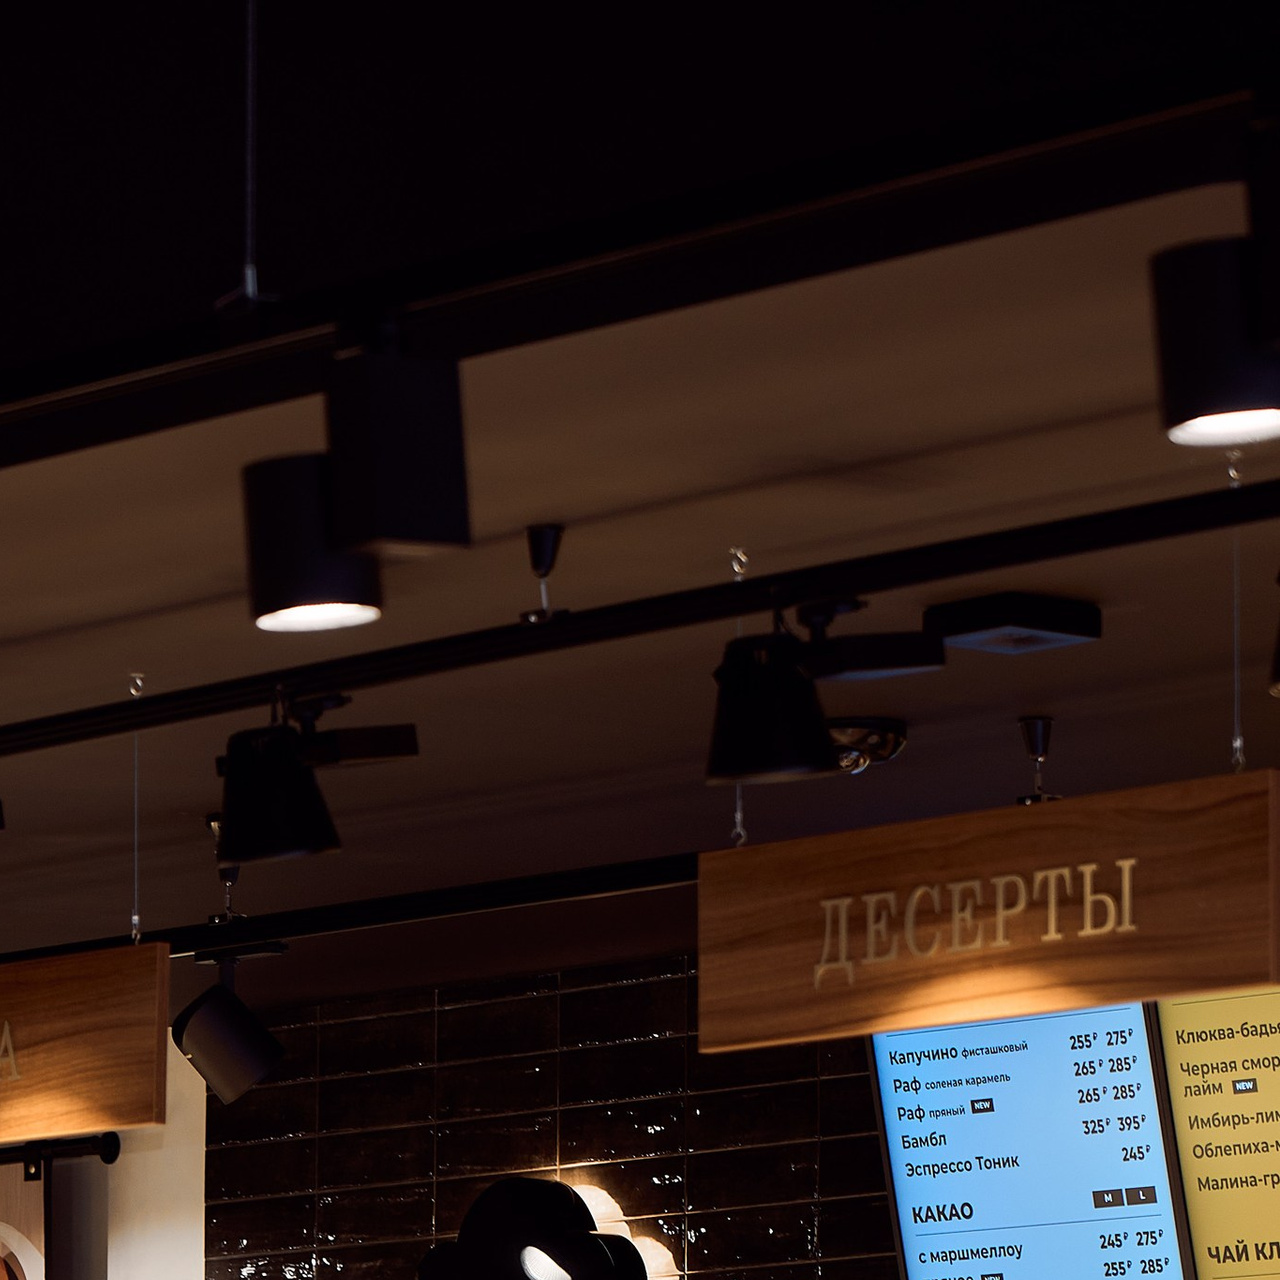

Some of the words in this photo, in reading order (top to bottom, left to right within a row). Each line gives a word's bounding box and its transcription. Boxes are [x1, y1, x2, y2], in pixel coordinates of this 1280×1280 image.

[813, 858, 1138, 990] ДЕСЕРТЫ
[889, 1047, 958, 1066] Капучино
[961, 1040, 1028, 1059] фисташковый
[1180, 1059, 1237, 1079] Черная
[893, 1076, 921, 1094] Раф
[925, 1078, 963, 1090] соленая
[965, 1073, 1010, 1087] карамель
[1184, 1080, 1223, 1098] лайм
[1235, 1081, 1254, 1091] NEW
[897, 1104, 925, 1122] Раф
[929, 1105, 965, 1120] пряный
[973, 1101, 991, 1110] NEW
[901, 1131, 947, 1149] Бамбл
[905, 1160, 972, 1178] Эспрессо
[975, 1155, 1020, 1171] Тоник
[1197, 1173, 1280, 1192] Малина-гр
[911, 1202, 974, 1224] КАКАО
[1138, 1190, 1146, 1200] L
[918, 1252, 927, 1263] с
[930, 1243, 1022, 1265] маршмеллоу
[1207, 1239, 1250, 1264] ЧАЙ
